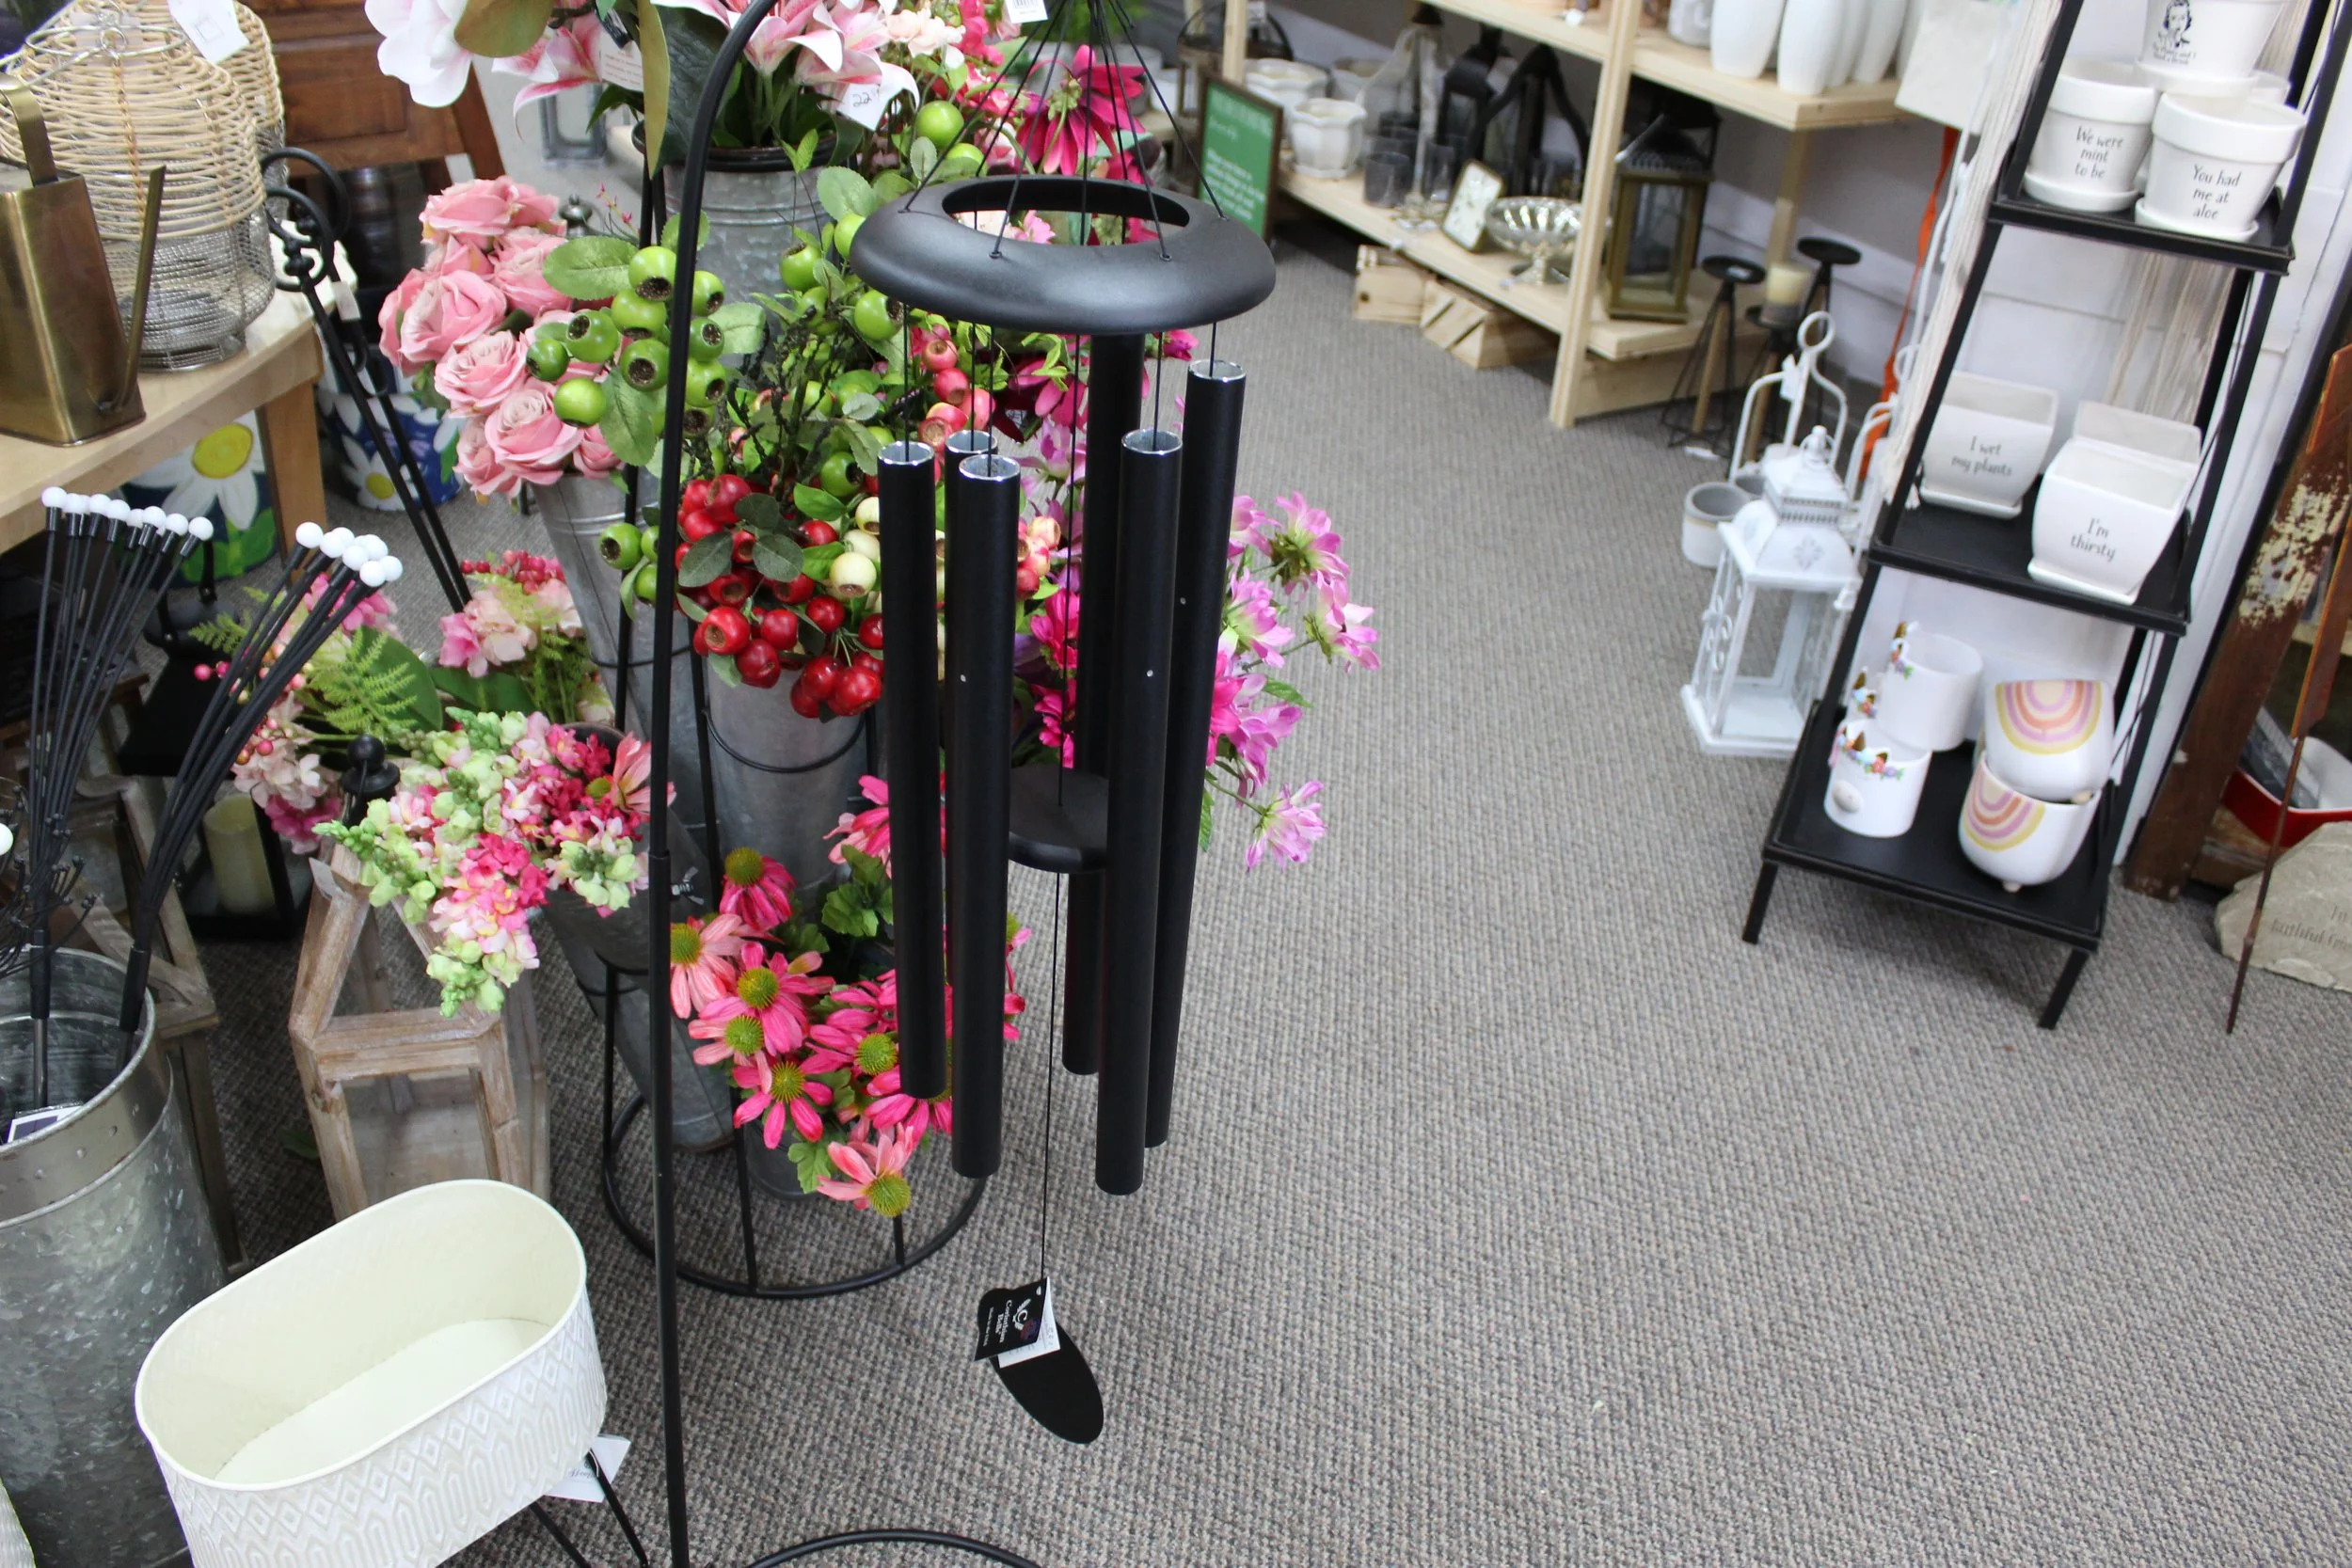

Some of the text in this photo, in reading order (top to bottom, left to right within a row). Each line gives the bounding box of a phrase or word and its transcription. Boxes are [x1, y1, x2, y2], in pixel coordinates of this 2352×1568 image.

[2076, 125, 2124, 149] We were
[2080, 149, 2108, 162] mint
[2074, 163, 2106, 179] to be
[2193, 164, 2242, 187] You had
[2193, 188, 2230, 204] me at
[2193, 203, 2218, 220] aloe
[1970, 436, 2002, 456] I wet
[1951, 455, 2013, 477] my plants
[2087, 517, 2109, 539] I'm
[2070, 533, 2116, 562] thirsty
